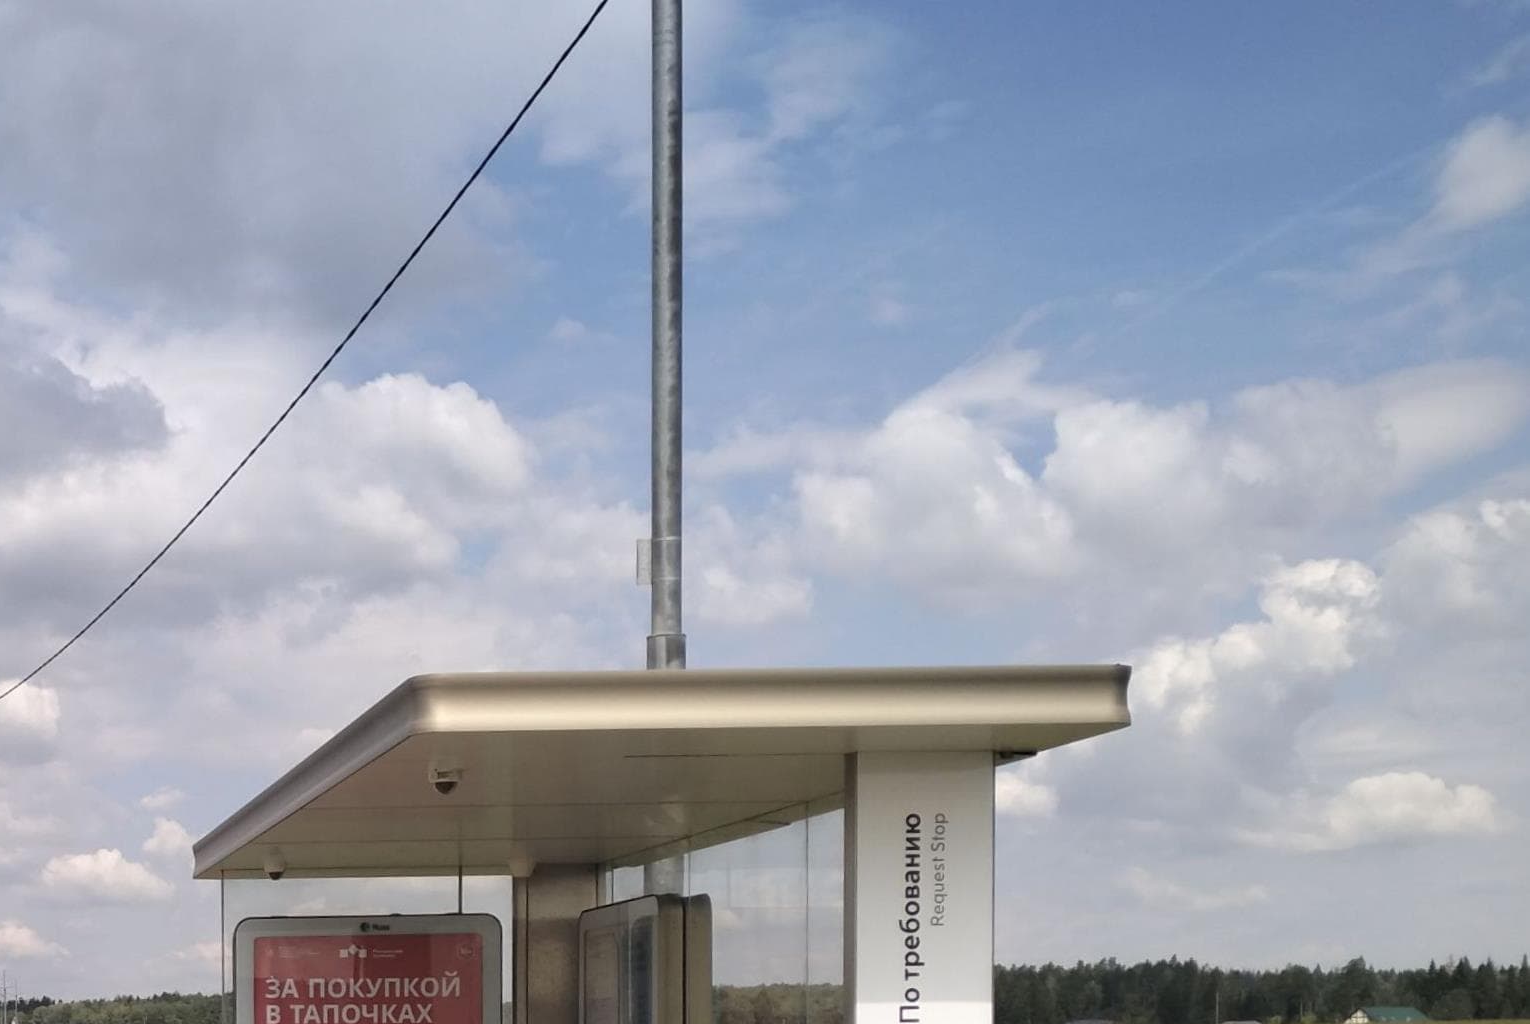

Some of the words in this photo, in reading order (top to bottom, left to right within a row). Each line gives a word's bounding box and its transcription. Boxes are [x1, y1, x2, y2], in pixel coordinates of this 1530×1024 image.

[930, 812, 949, 853] Stop
[898, 813, 925, 981] требованию
[930, 858, 948, 927] Request
[265, 977, 299, 999] ЗА
[308, 970, 461, 999] ПОКУПКОЙ
[266, 1004, 281, 1024] В
[290, 1003, 433, 1024] ТАПОЧКАХ
[898, 987, 921, 1024] По
